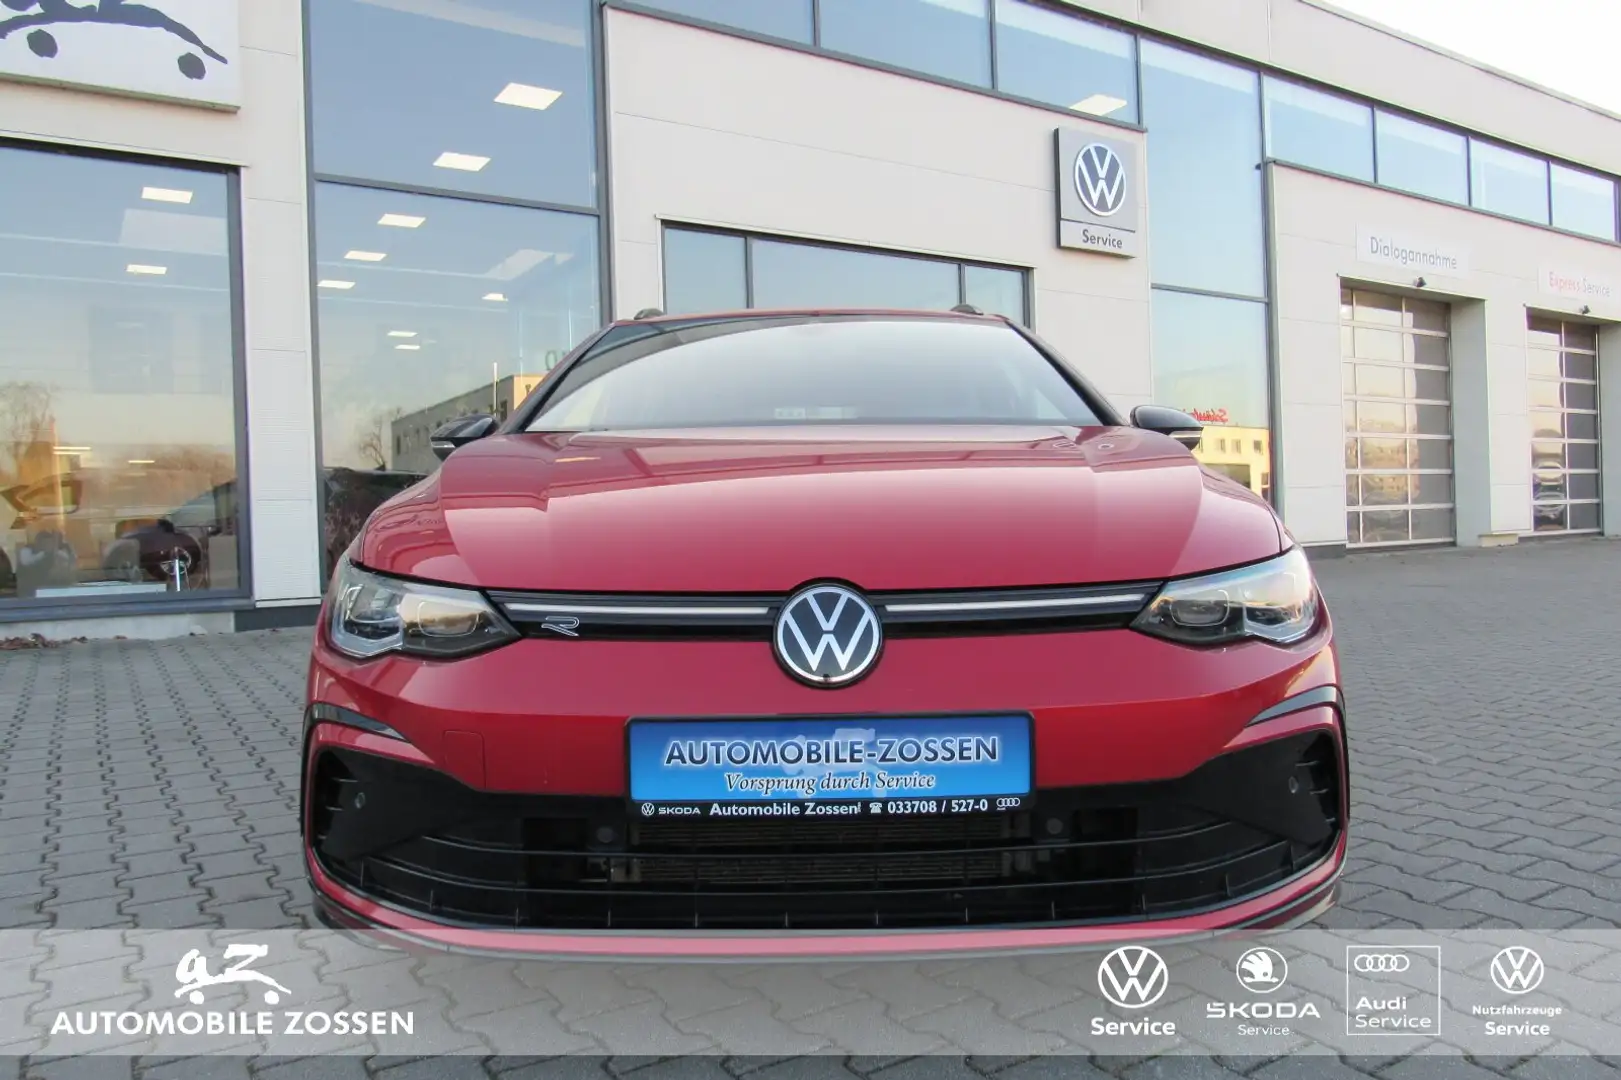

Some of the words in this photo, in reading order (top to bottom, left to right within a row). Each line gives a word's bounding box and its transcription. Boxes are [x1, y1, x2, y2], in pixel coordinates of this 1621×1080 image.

[1075, 143, 1126, 216] VW
[1082, 229, 1122, 249] Service
[1369, 236, 1457, 269] Dialogannahme
[1549, 271, 1580, 292] Express
[1583, 276, 1610, 297] Service
[777, 586, 882, 684] VW
[665, 737, 998, 765] AUTOMOBILE-ZOSSEN
[725, 773, 816, 795] Vorsprung
[821, 772, 869, 789] durch
[876, 771, 935, 788] Service
[710, 803, 800, 816] Automobile
[805, 802, 857, 815] Zossen
[888, 801, 937, 814] 033708
[951, 799, 988, 812] 527-0
